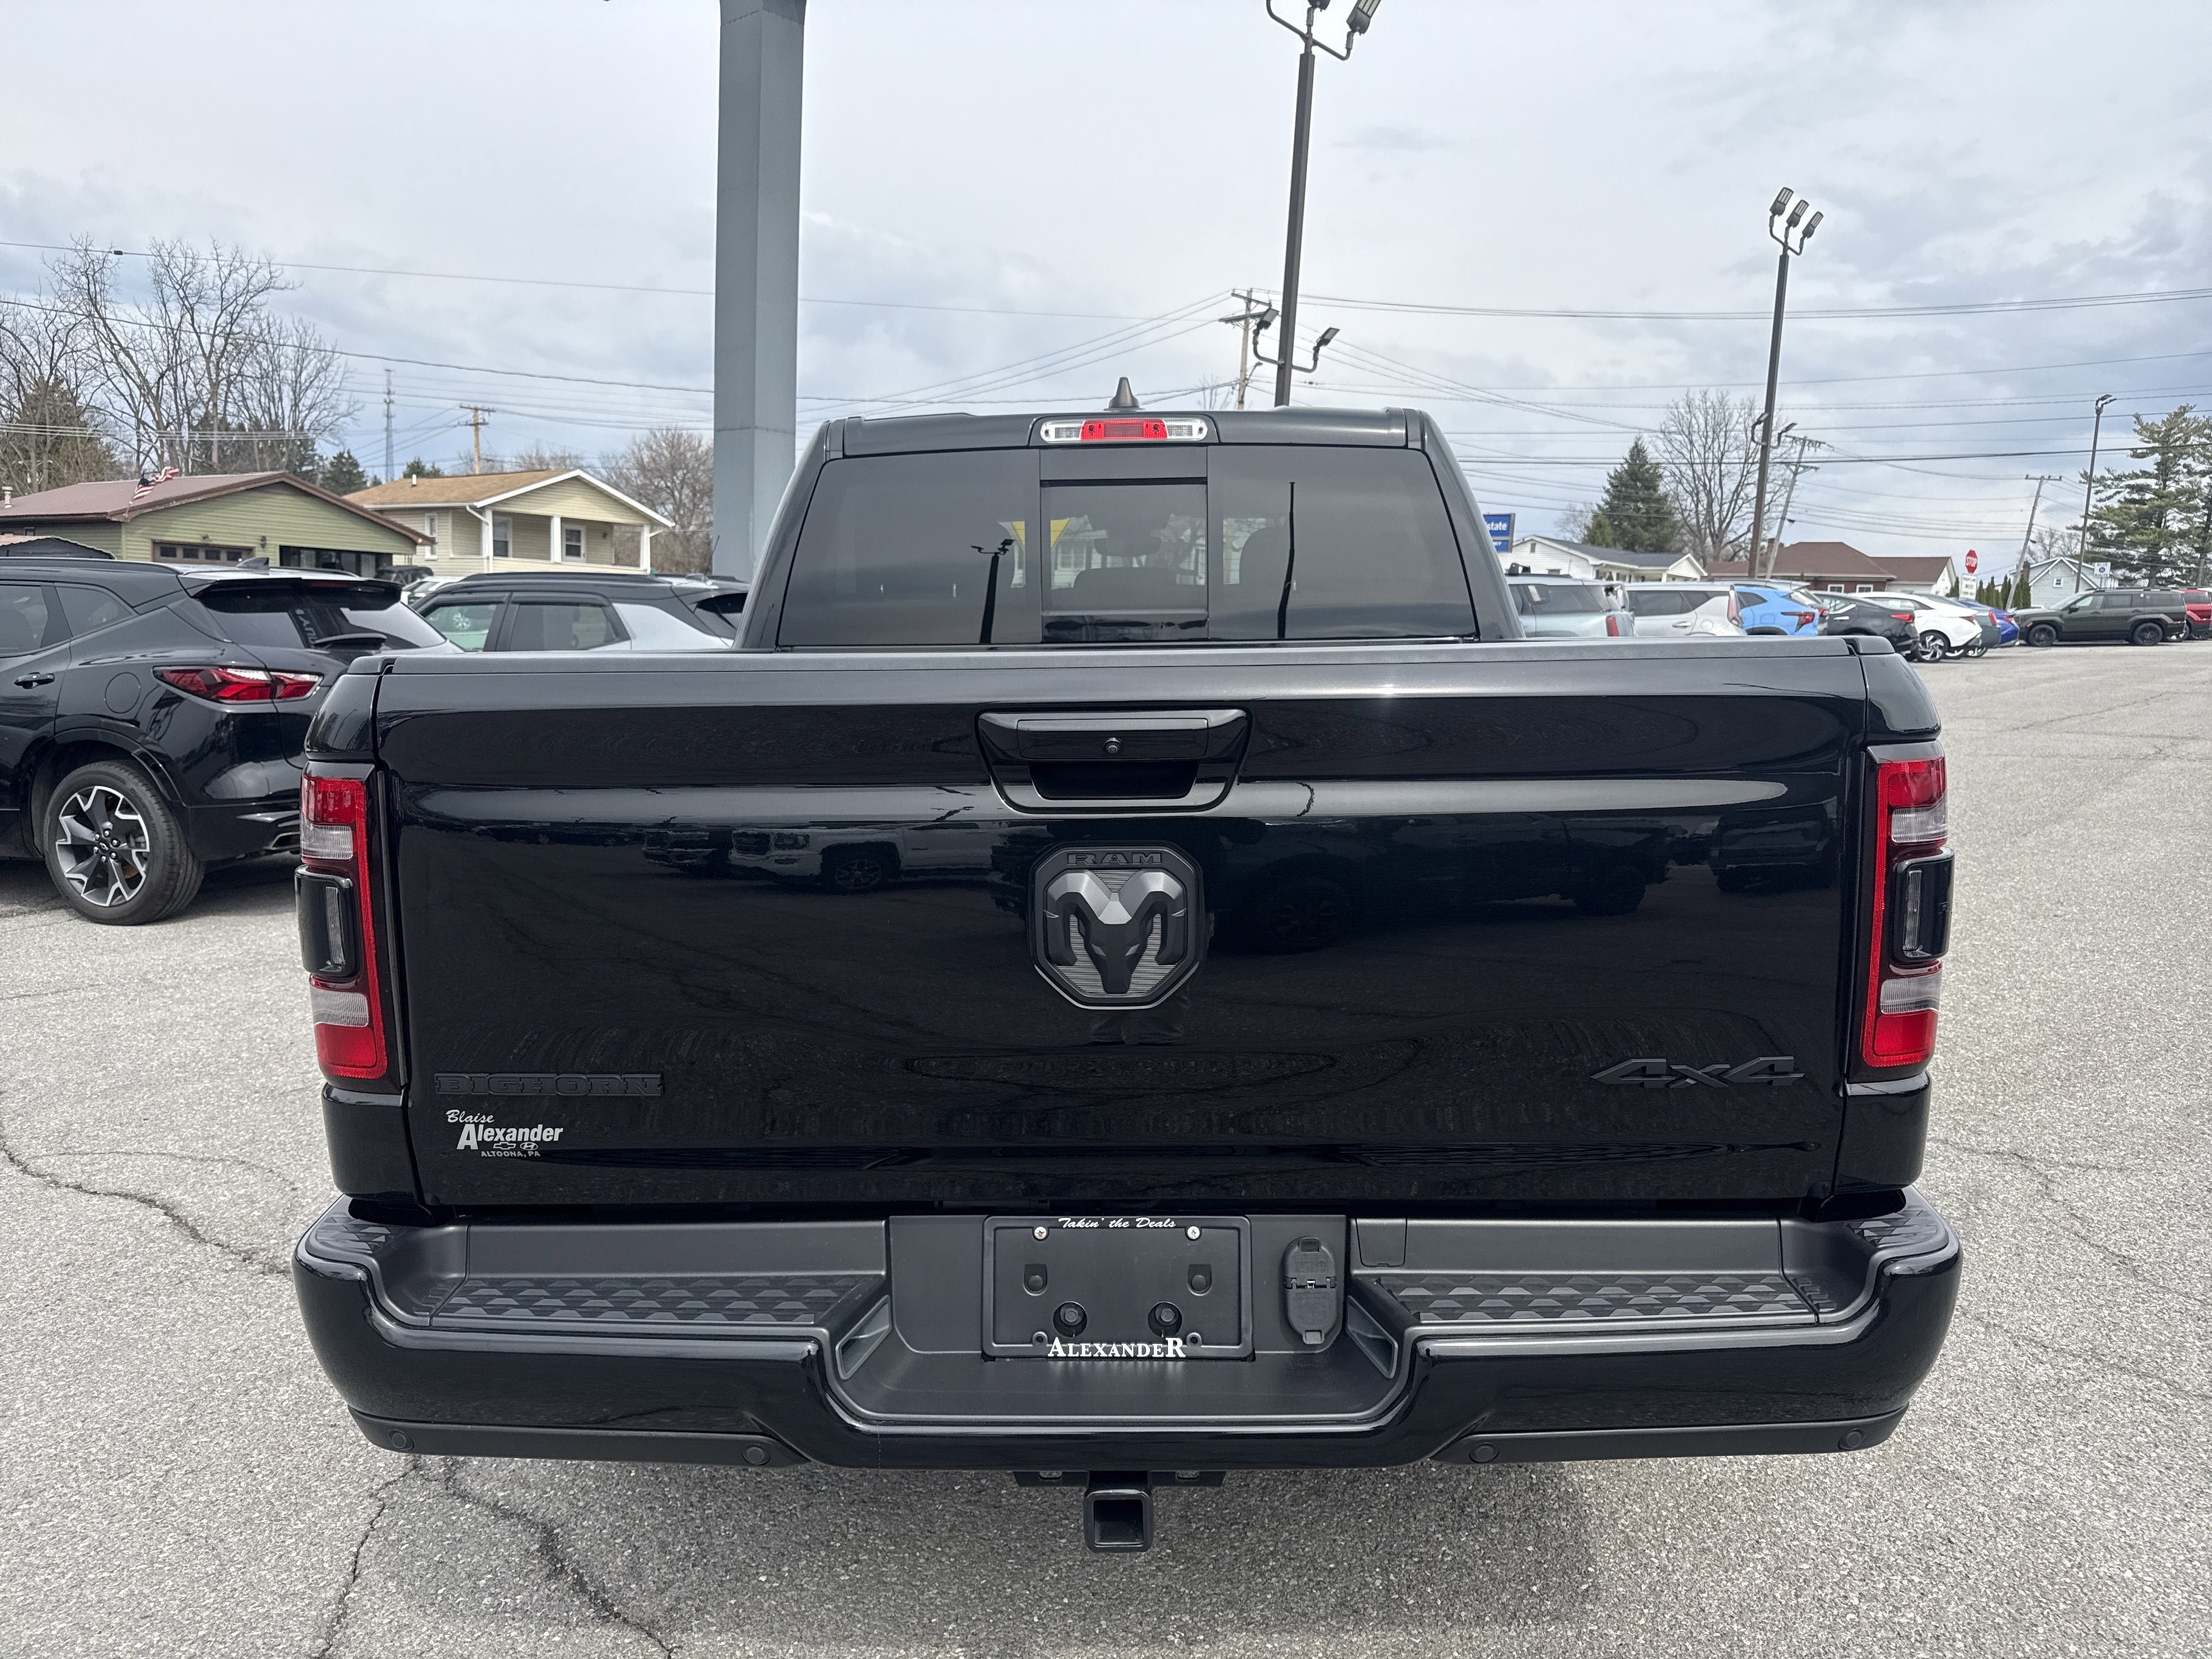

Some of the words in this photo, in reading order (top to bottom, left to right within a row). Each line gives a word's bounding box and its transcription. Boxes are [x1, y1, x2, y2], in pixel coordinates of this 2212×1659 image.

[1485, 521, 1507, 531] state
[1966, 556, 1977, 567] STOP
[1067, 852, 1163, 865] RAM
[445, 1109, 495, 1123] Blaise
[456, 1124, 564, 1150] Alexander
[1058, 1217, 1105, 1228] Takin'
[1109, 1217, 1130, 1228] the
[1136, 1216, 1176, 1228] Deals
[1047, 1336, 1186, 1357] ALEXANDER
